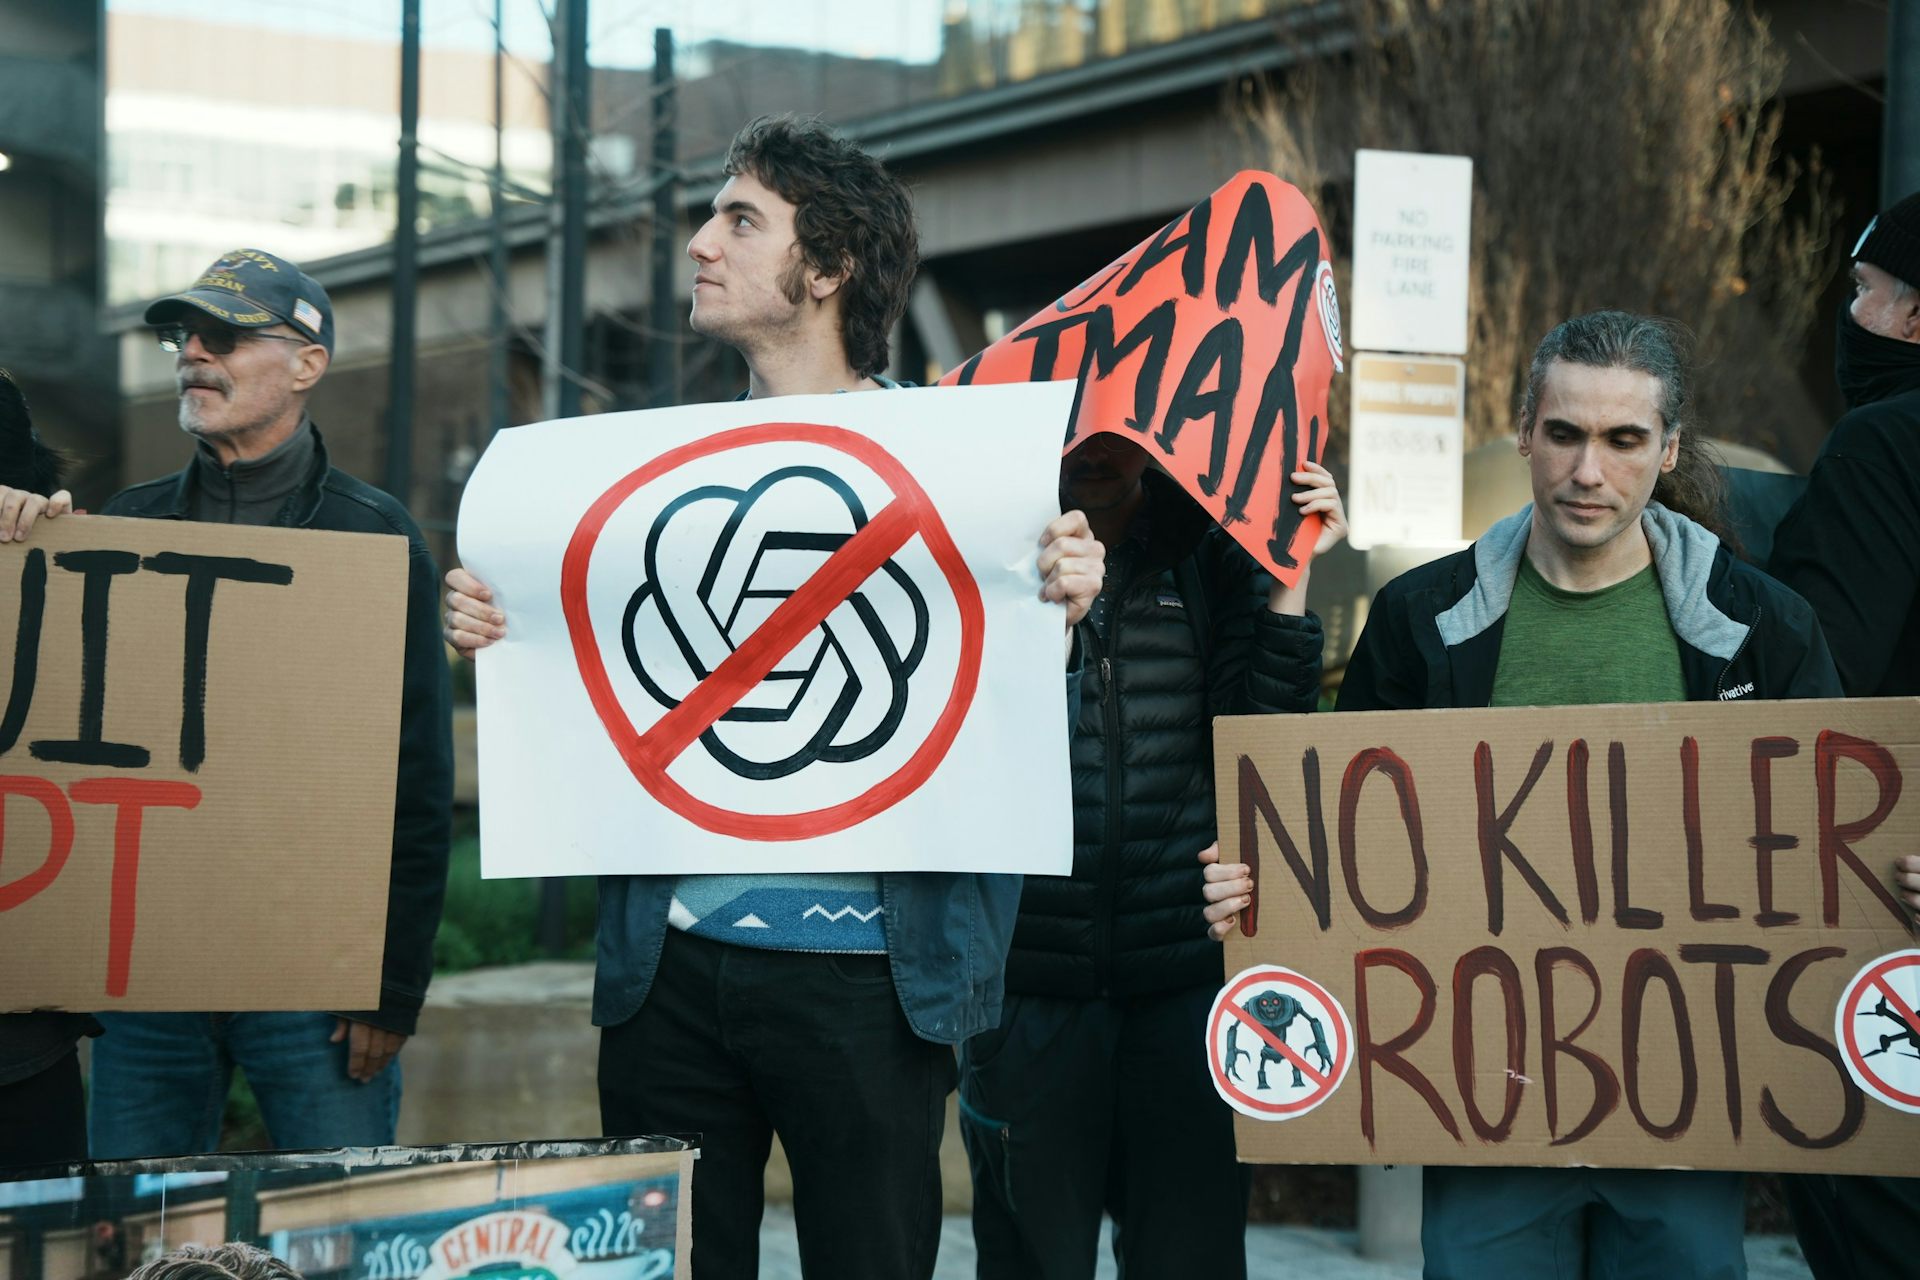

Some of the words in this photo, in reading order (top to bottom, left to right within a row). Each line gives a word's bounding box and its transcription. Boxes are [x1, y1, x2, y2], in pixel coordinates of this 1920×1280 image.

[1398, 208, 1429, 228] NO
[1370, 231, 1455, 254] PARKING
[1391, 255, 1430, 275] FIRE
[1385, 278, 1436, 299] LANE
[957, 297, 1320, 570] TMAN
[1238, 745, 1429, 938] NO
[1473, 729, 1917, 940] KILLER
[1354, 943, 1866, 1153] ROBOTS
[441, 1215, 557, 1270] CENTRAL
